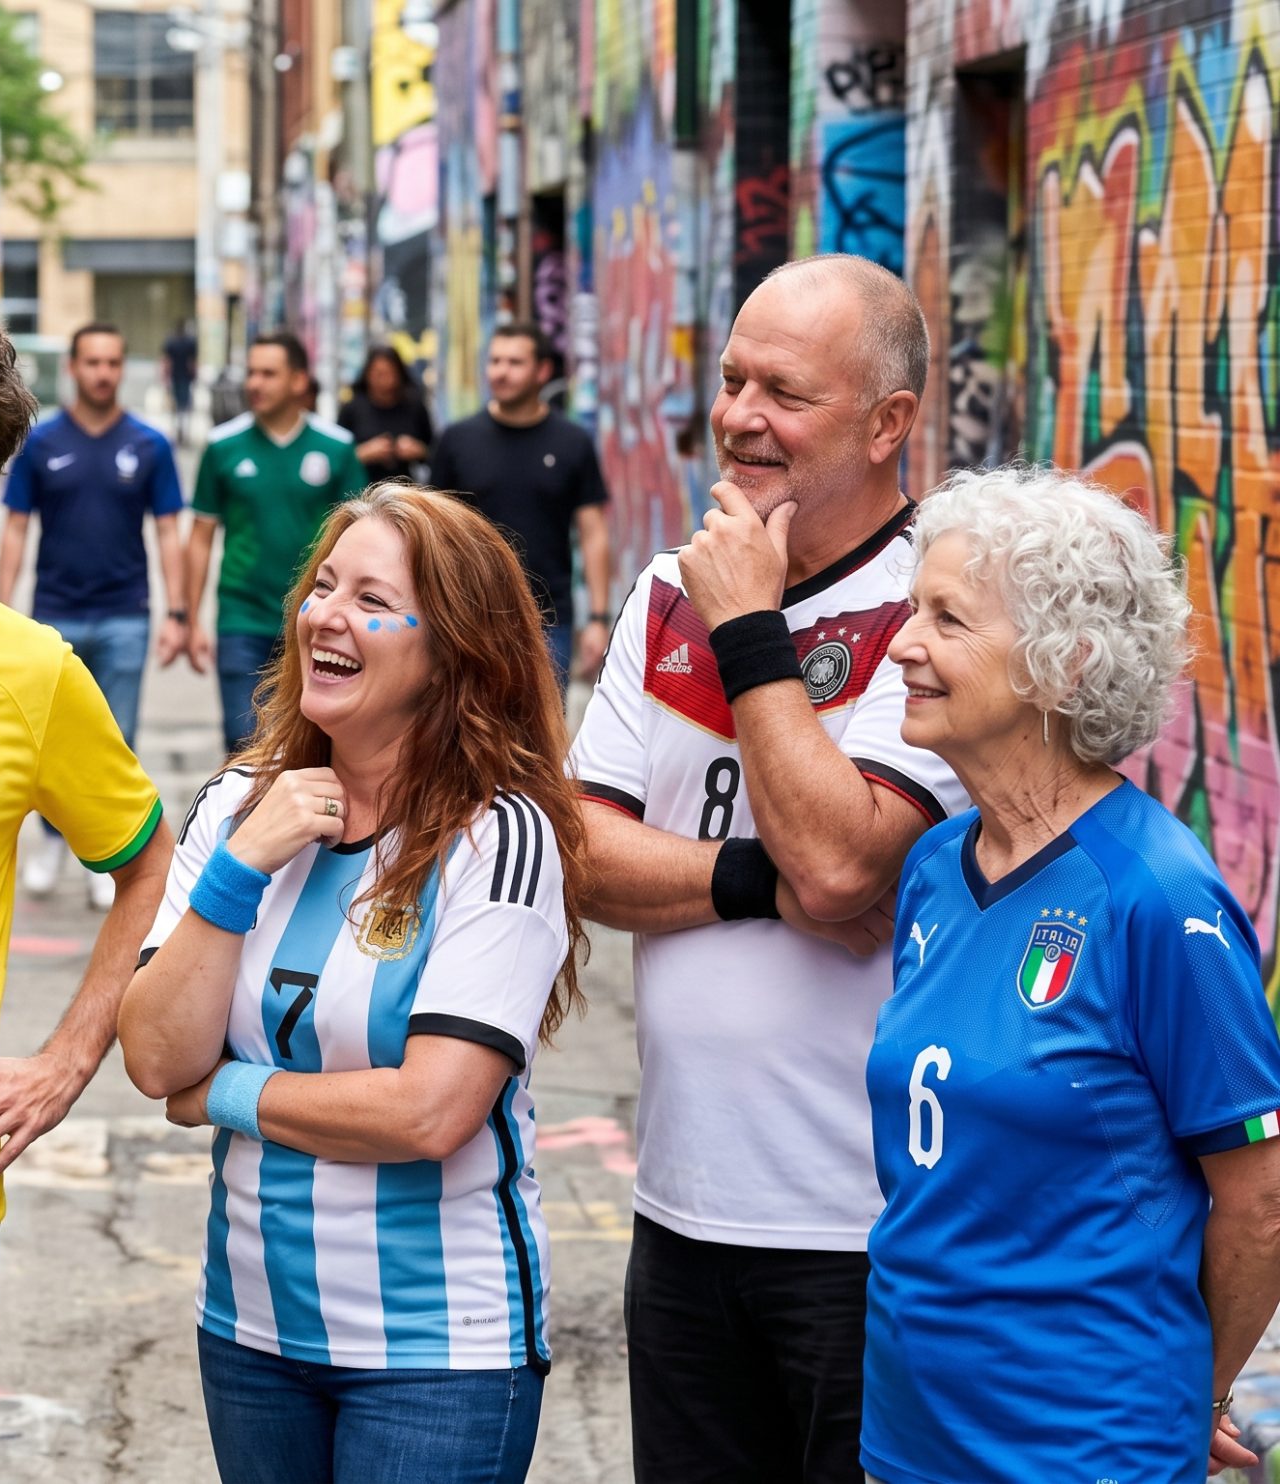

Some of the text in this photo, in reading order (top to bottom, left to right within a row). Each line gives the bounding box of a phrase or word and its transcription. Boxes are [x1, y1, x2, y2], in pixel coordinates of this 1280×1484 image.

[698, 756, 740, 842] 8
[1035, 929, 1079, 950] ITALIA
[269, 967, 320, 1060] 7
[908, 1044, 952, 1169] 6
